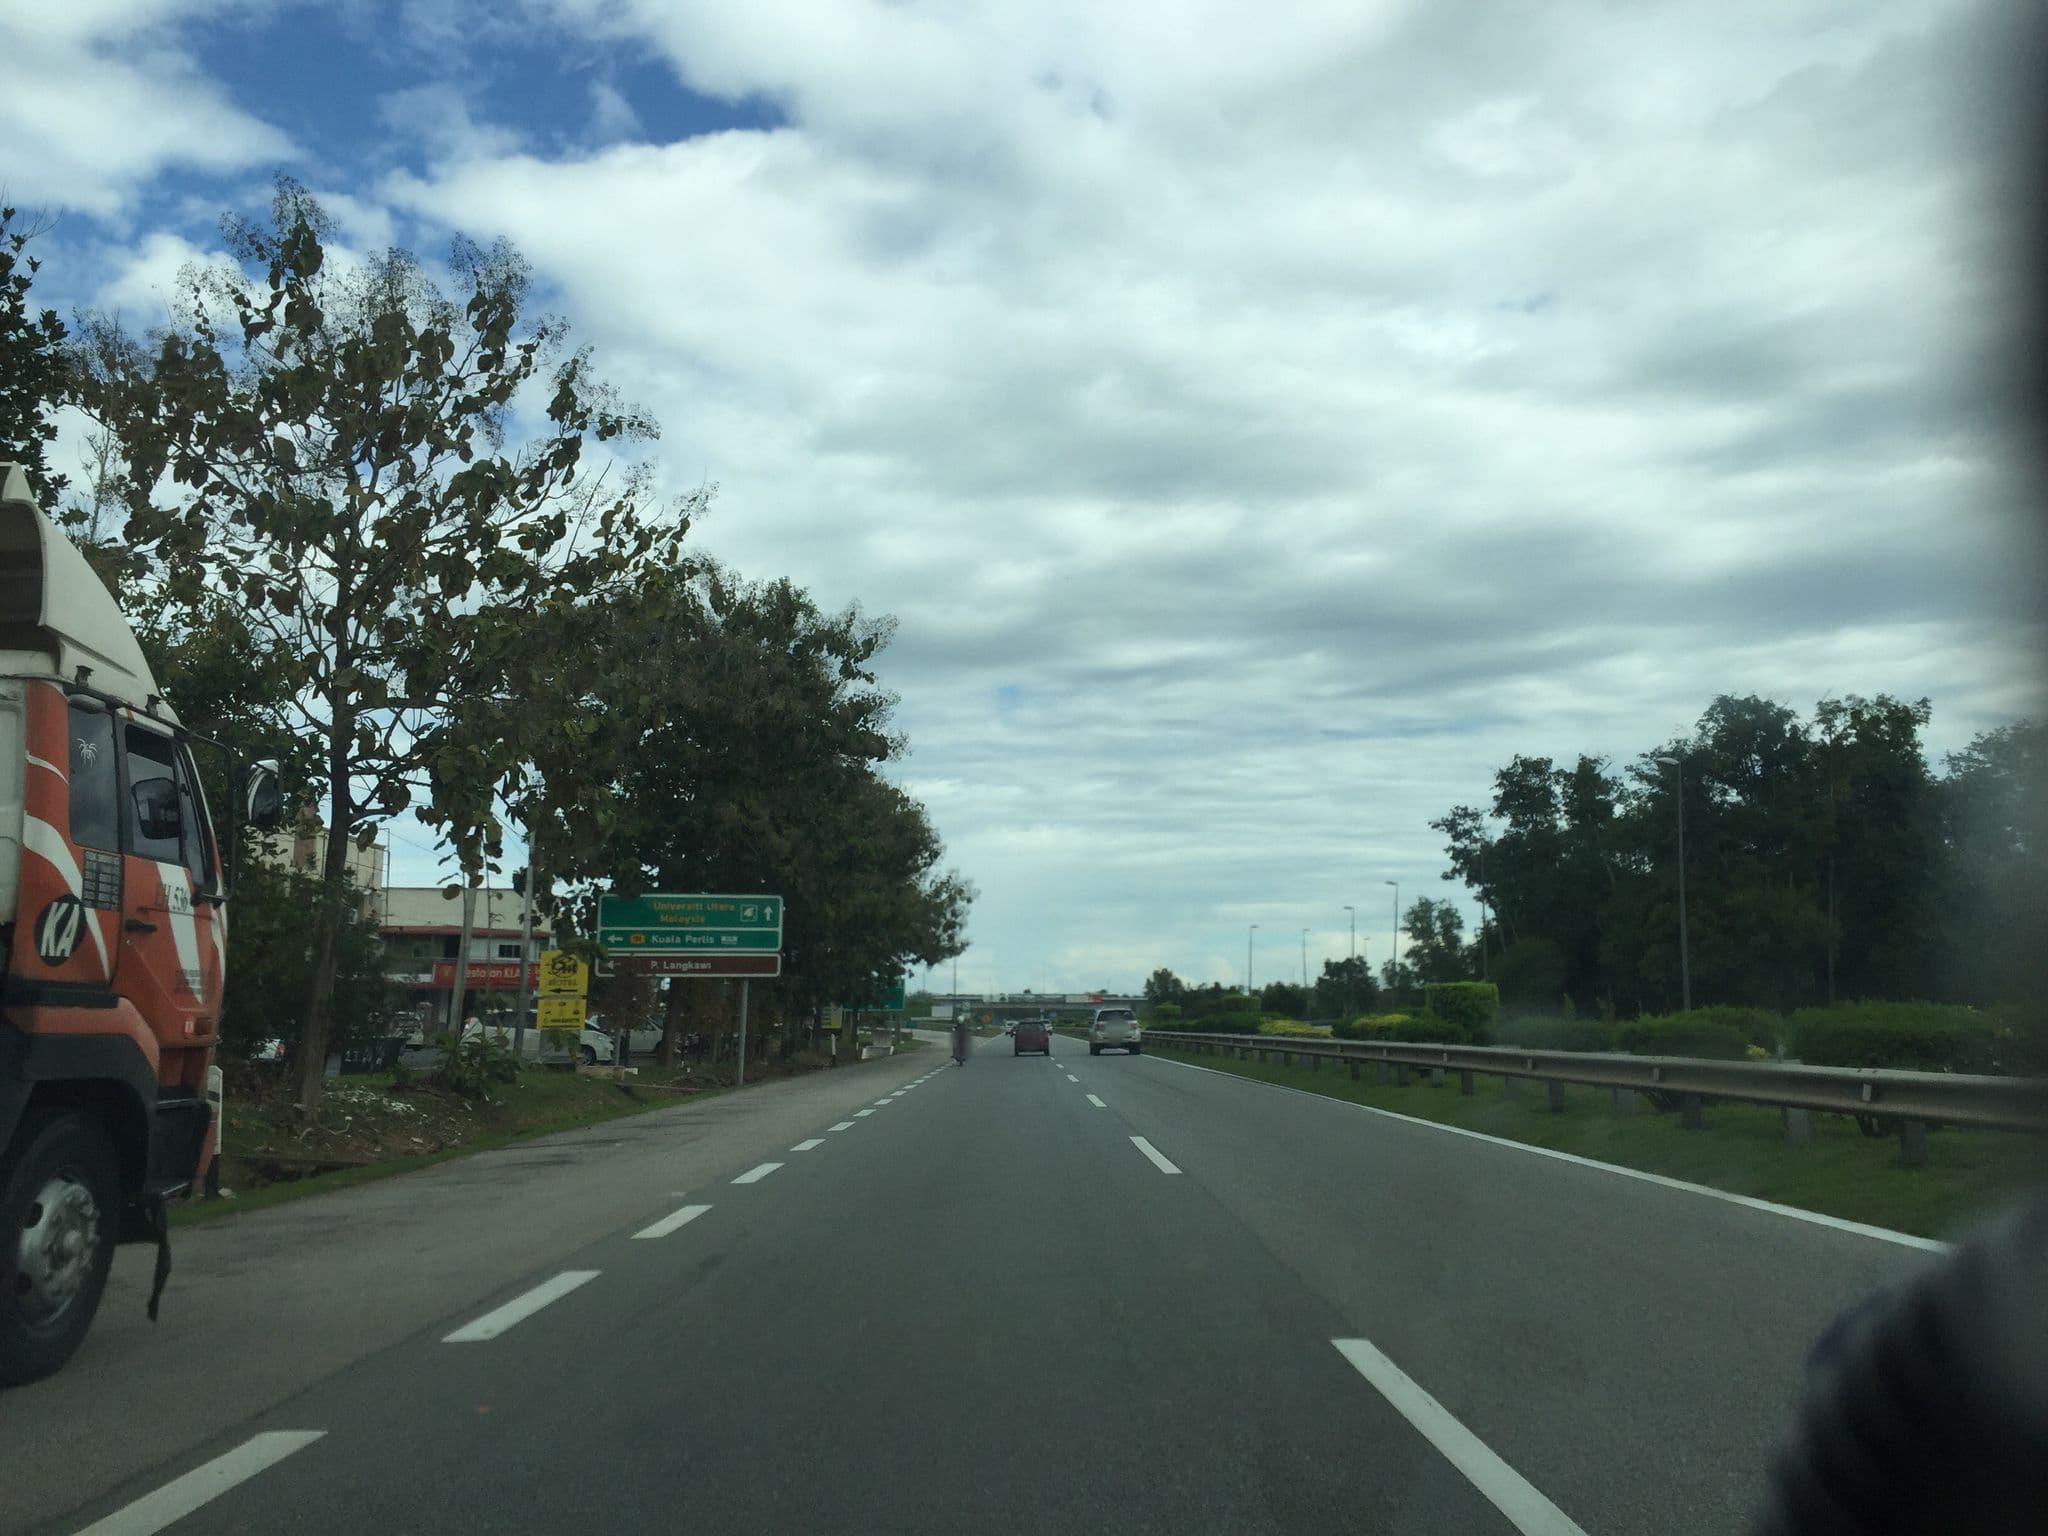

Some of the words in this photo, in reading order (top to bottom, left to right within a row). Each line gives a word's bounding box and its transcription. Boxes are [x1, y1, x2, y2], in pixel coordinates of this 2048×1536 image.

[655, 902, 704, 911] Universiti
[707, 902, 736, 911] Utara
[660, 914, 705, 924] Malaysia
[651, 934, 681, 944] Kuala
[685, 934, 715, 944] Perlis
[650, 960, 659, 970] P.
[663, 960, 712, 972] Langkawi
